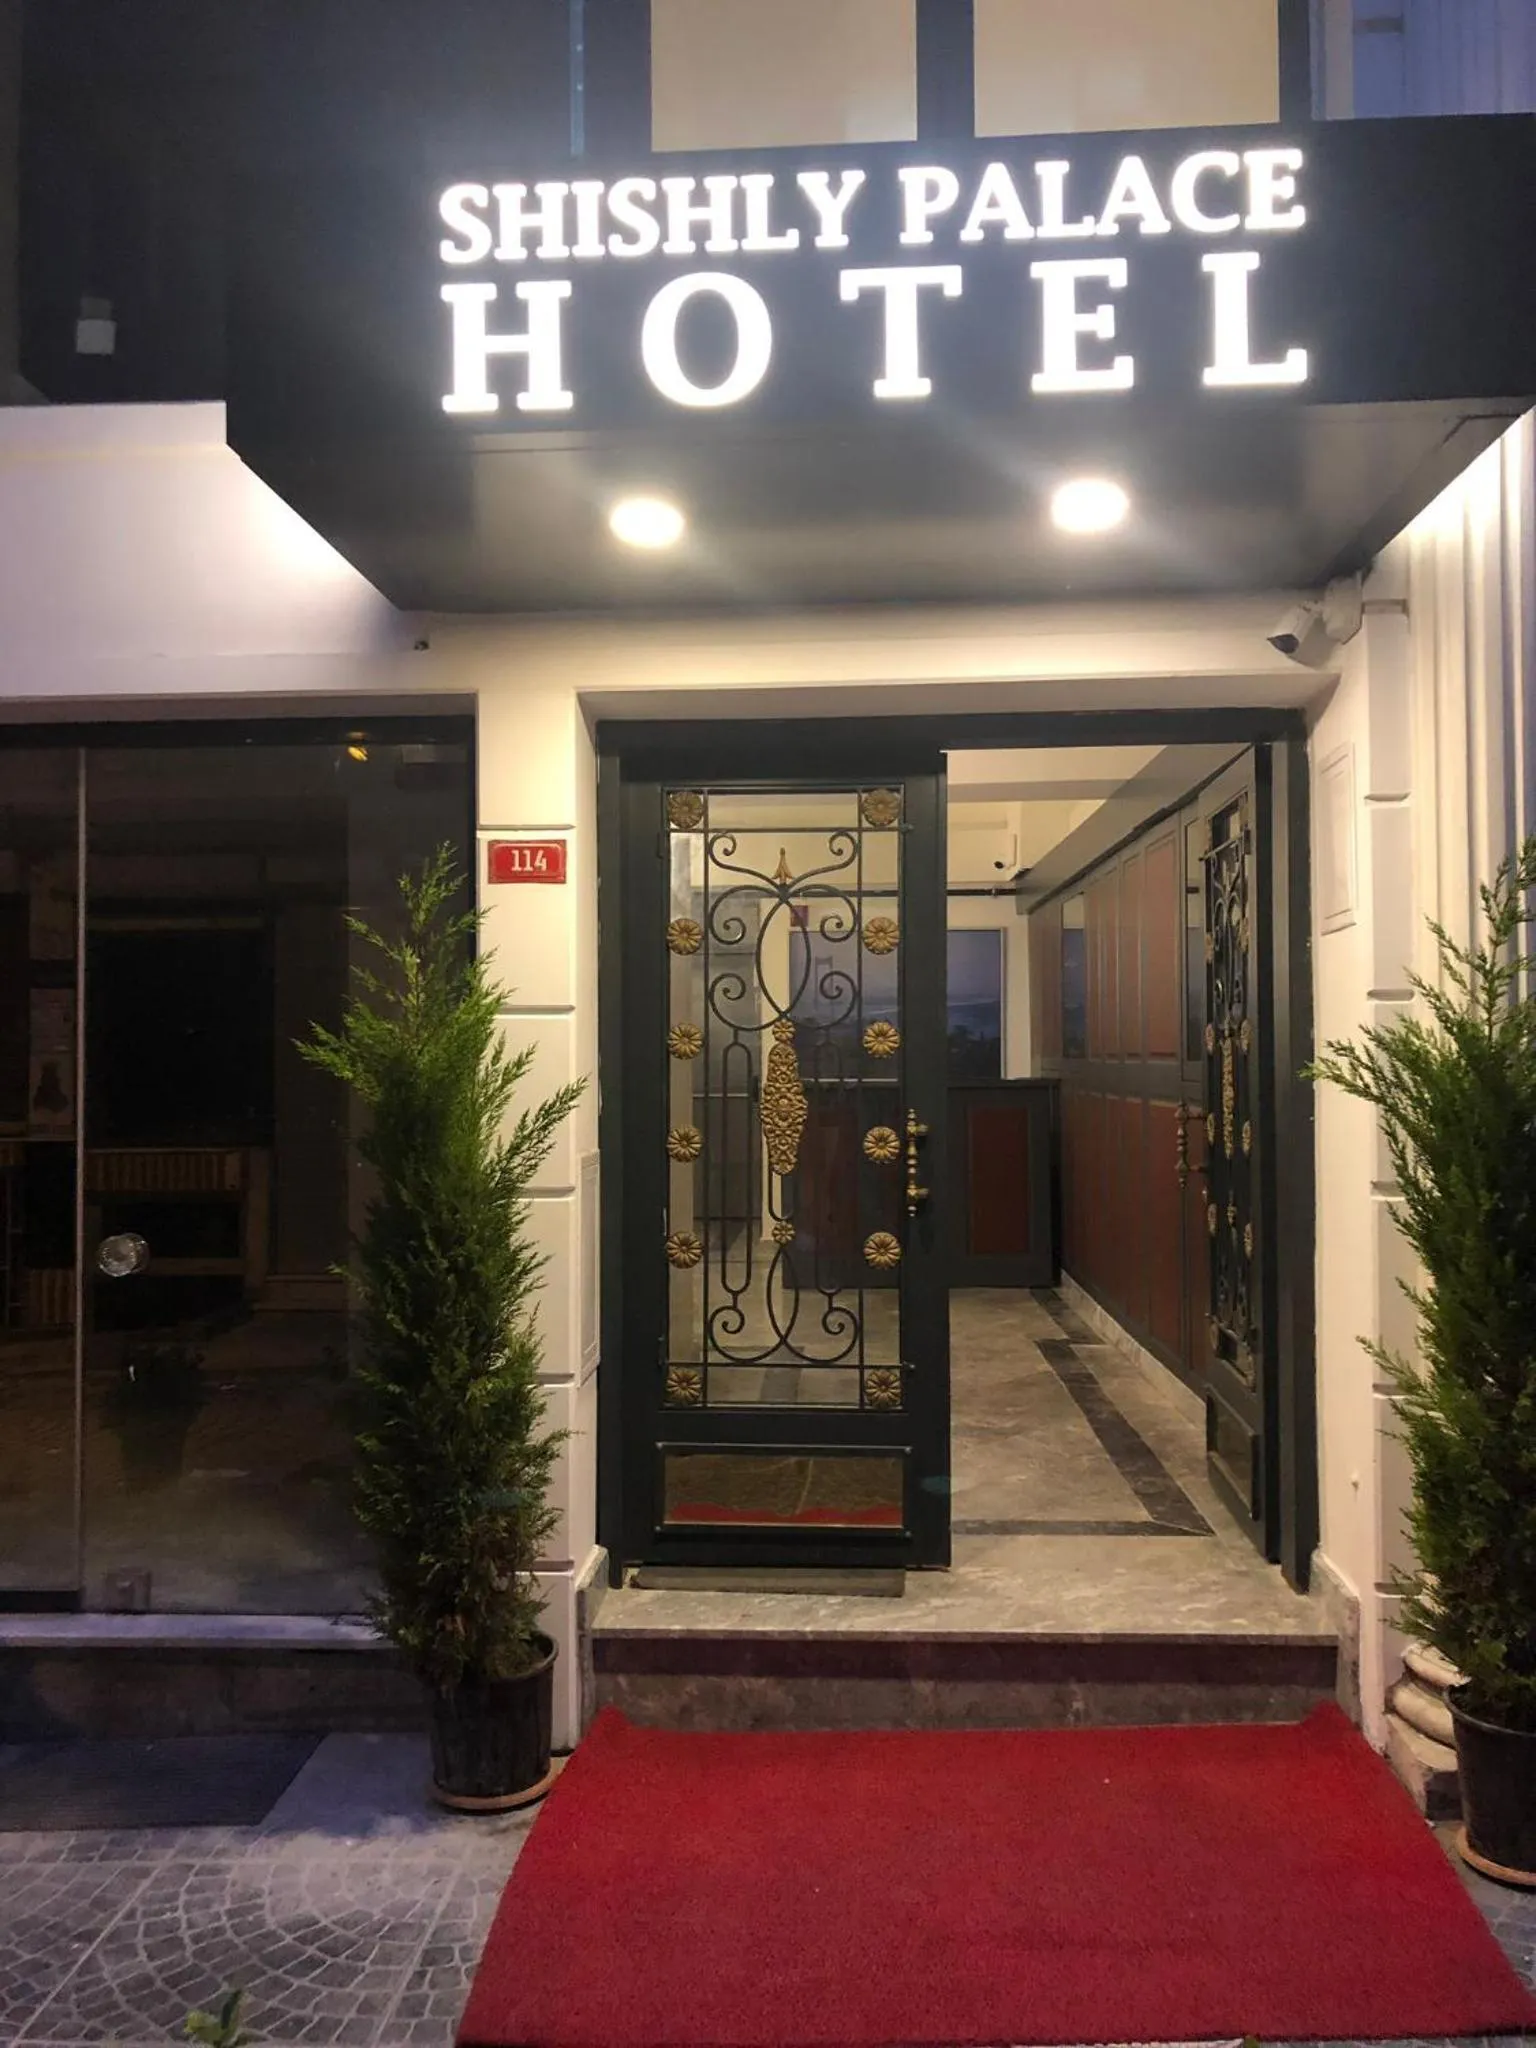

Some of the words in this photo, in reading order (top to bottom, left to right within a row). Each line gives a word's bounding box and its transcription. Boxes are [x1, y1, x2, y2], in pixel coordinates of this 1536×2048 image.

[438, 169, 867, 265] SHISHLY
[897, 147, 1308, 245] PALACE
[439, 250, 1309, 414] HOTEL
[511, 849, 547, 872] 114
